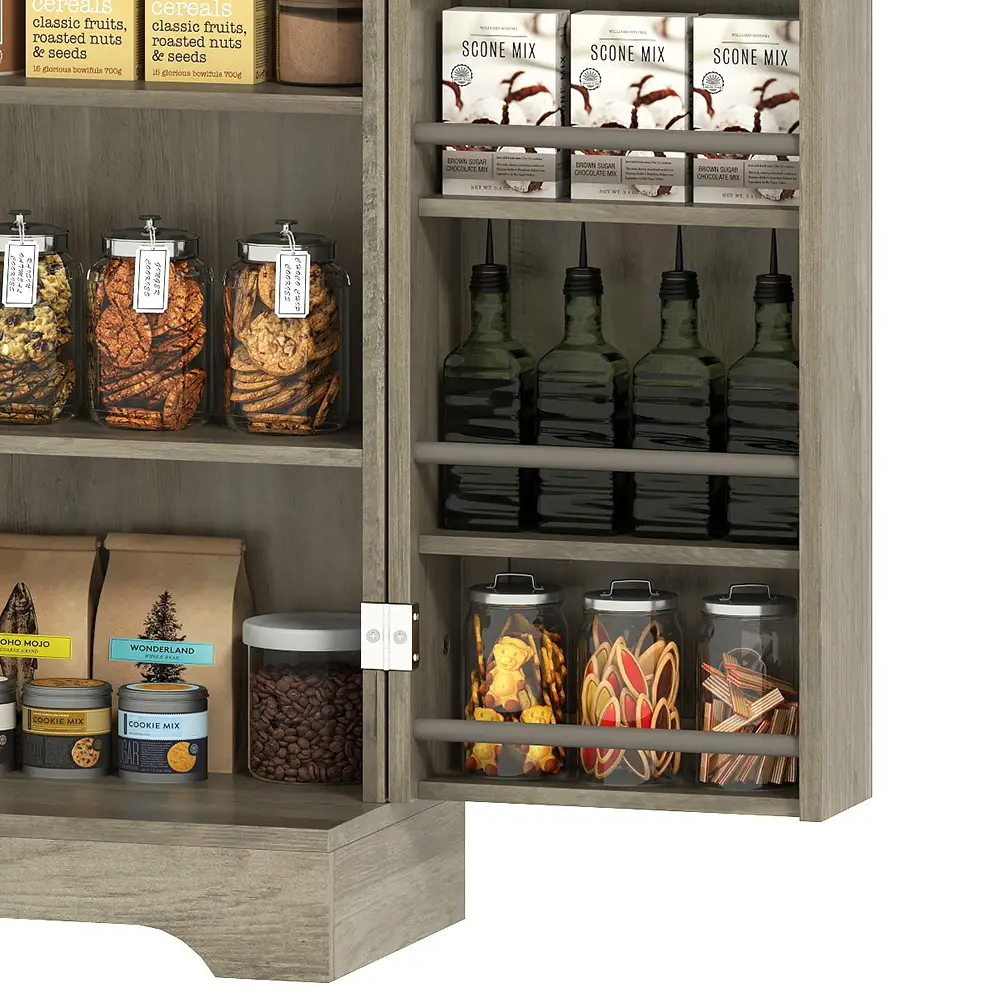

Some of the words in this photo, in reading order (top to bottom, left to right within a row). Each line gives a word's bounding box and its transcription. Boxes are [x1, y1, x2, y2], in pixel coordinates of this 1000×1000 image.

[151, 0, 232, 17] cereals
[33, 17, 81, 29] classic
[84, 17, 128, 32] fruits,
[152, 20, 200, 32] classic
[204, 21, 248, 36] fruits,
[32, 33, 85, 45] roasted
[90, 34, 122, 45] nuts
[152, 36, 205, 48] roasted
[210, 38, 242, 49] nuts
[32, 46, 45, 58] &
[48, 48, 87, 59] seeds
[462, 40, 505, 58] SCONE
[512, 42, 536, 58] MIX
[590, 44, 634, 61] SCONE
[642, 46, 664, 62] MIX
[152, 50, 164, 61] &
[168, 52, 207, 63] seeds
[713, 48, 757, 65] SCONE
[764, 50, 788, 66] MIX
[42, 66, 71, 74] glorious
[73, 66, 103, 74] bowlfuls
[104, 67, 122, 75] 700g
[162, 70, 191, 78] glorious
[192, 70, 222, 78] bowlfuls
[224, 70, 242, 79] 700g
[24, 639, 50, 648] MOJO
[130, 644, 195, 655] WONDERLAND
[32, 717, 64, 725] COOKIE
[129, 721, 160, 729] COOKIE
